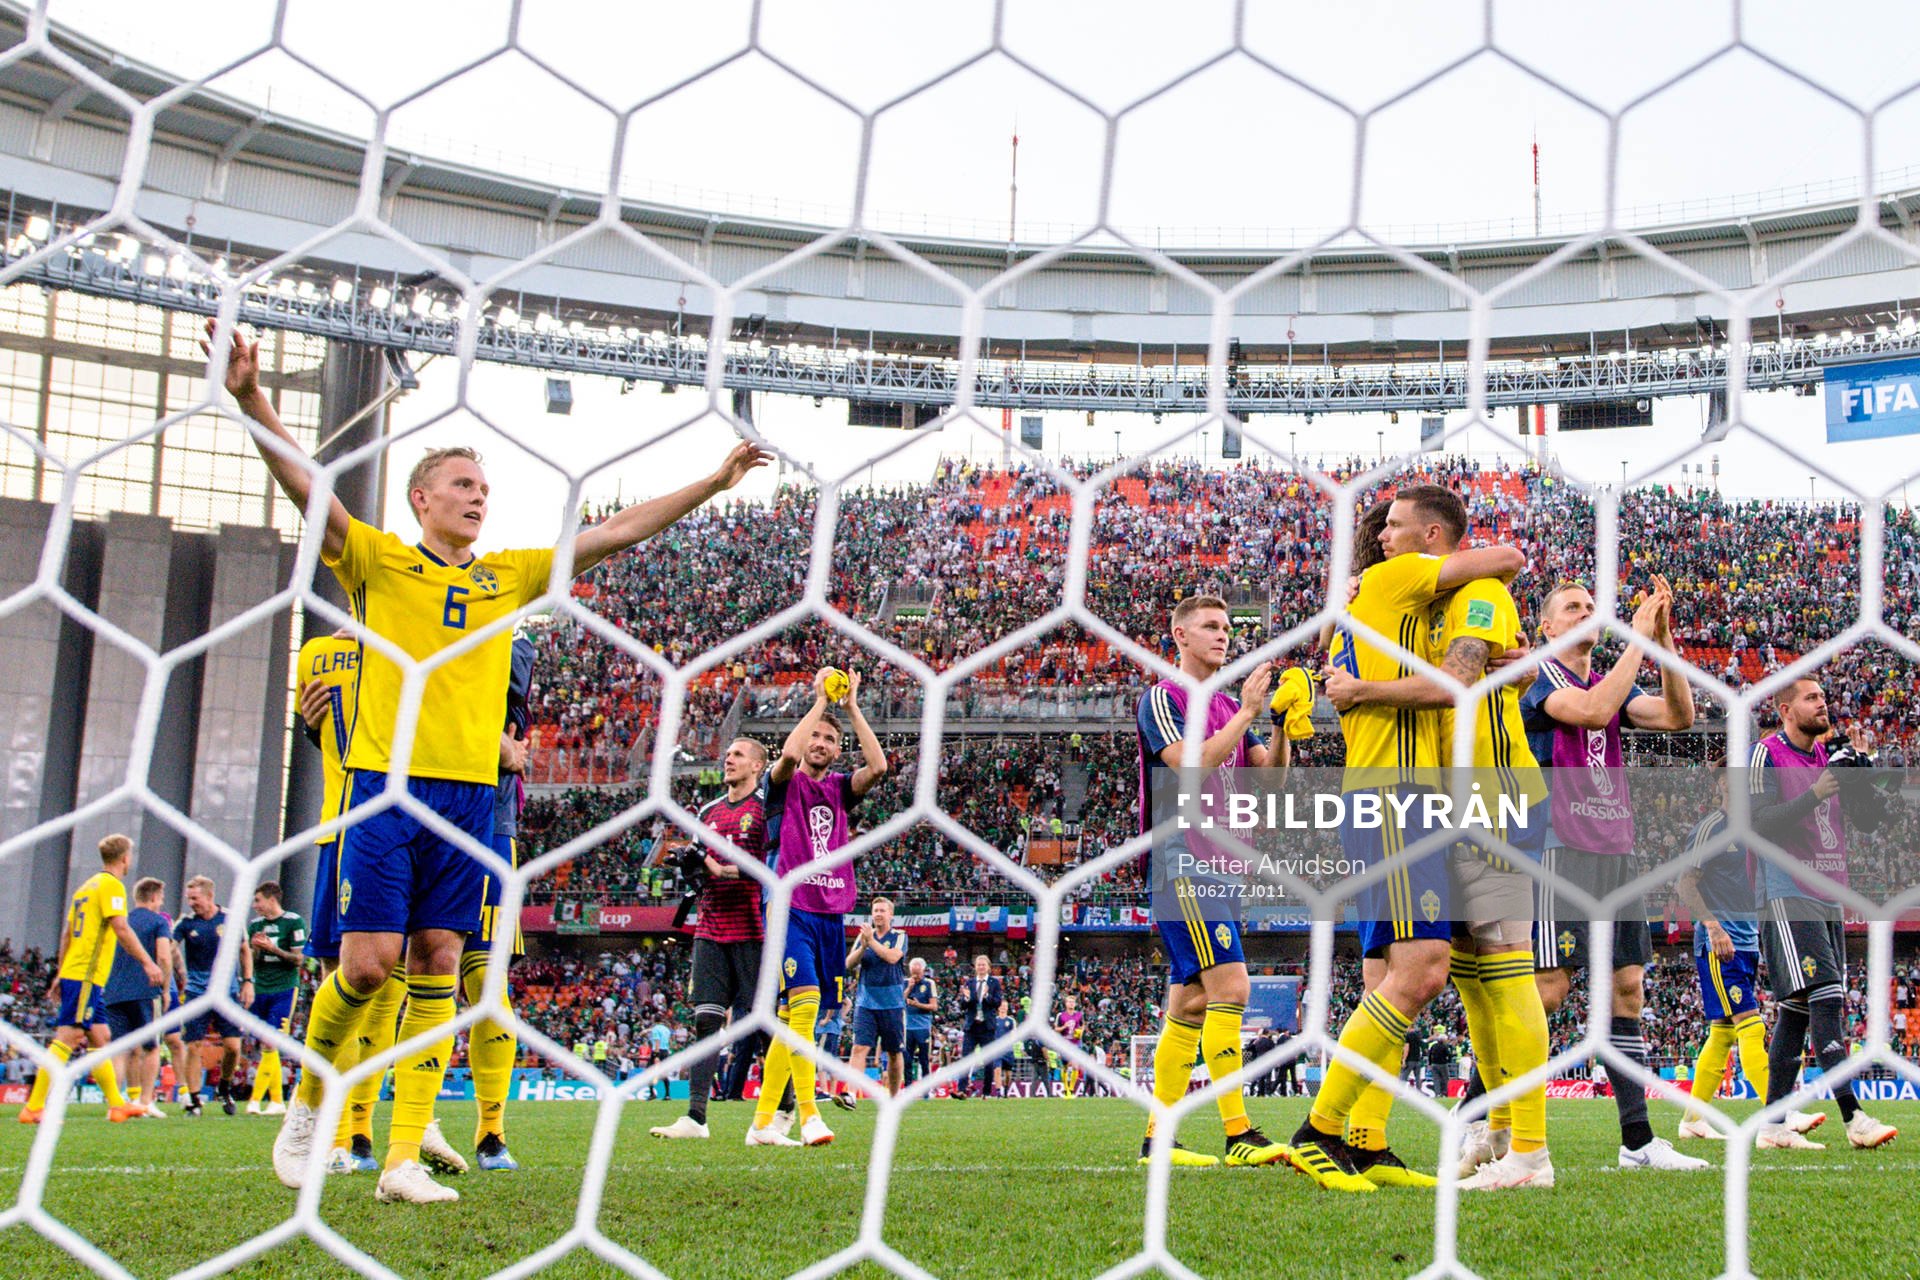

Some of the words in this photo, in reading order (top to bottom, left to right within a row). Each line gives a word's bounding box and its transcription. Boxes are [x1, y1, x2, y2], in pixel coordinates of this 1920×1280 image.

[1841, 383, 1919, 417] FIFA
[443, 585, 469, 629] 6
[312, 651, 360, 675] CLAE
[1267, 913, 1312, 926] RUSSI
[518, 1080, 658, 1101] Hisee
